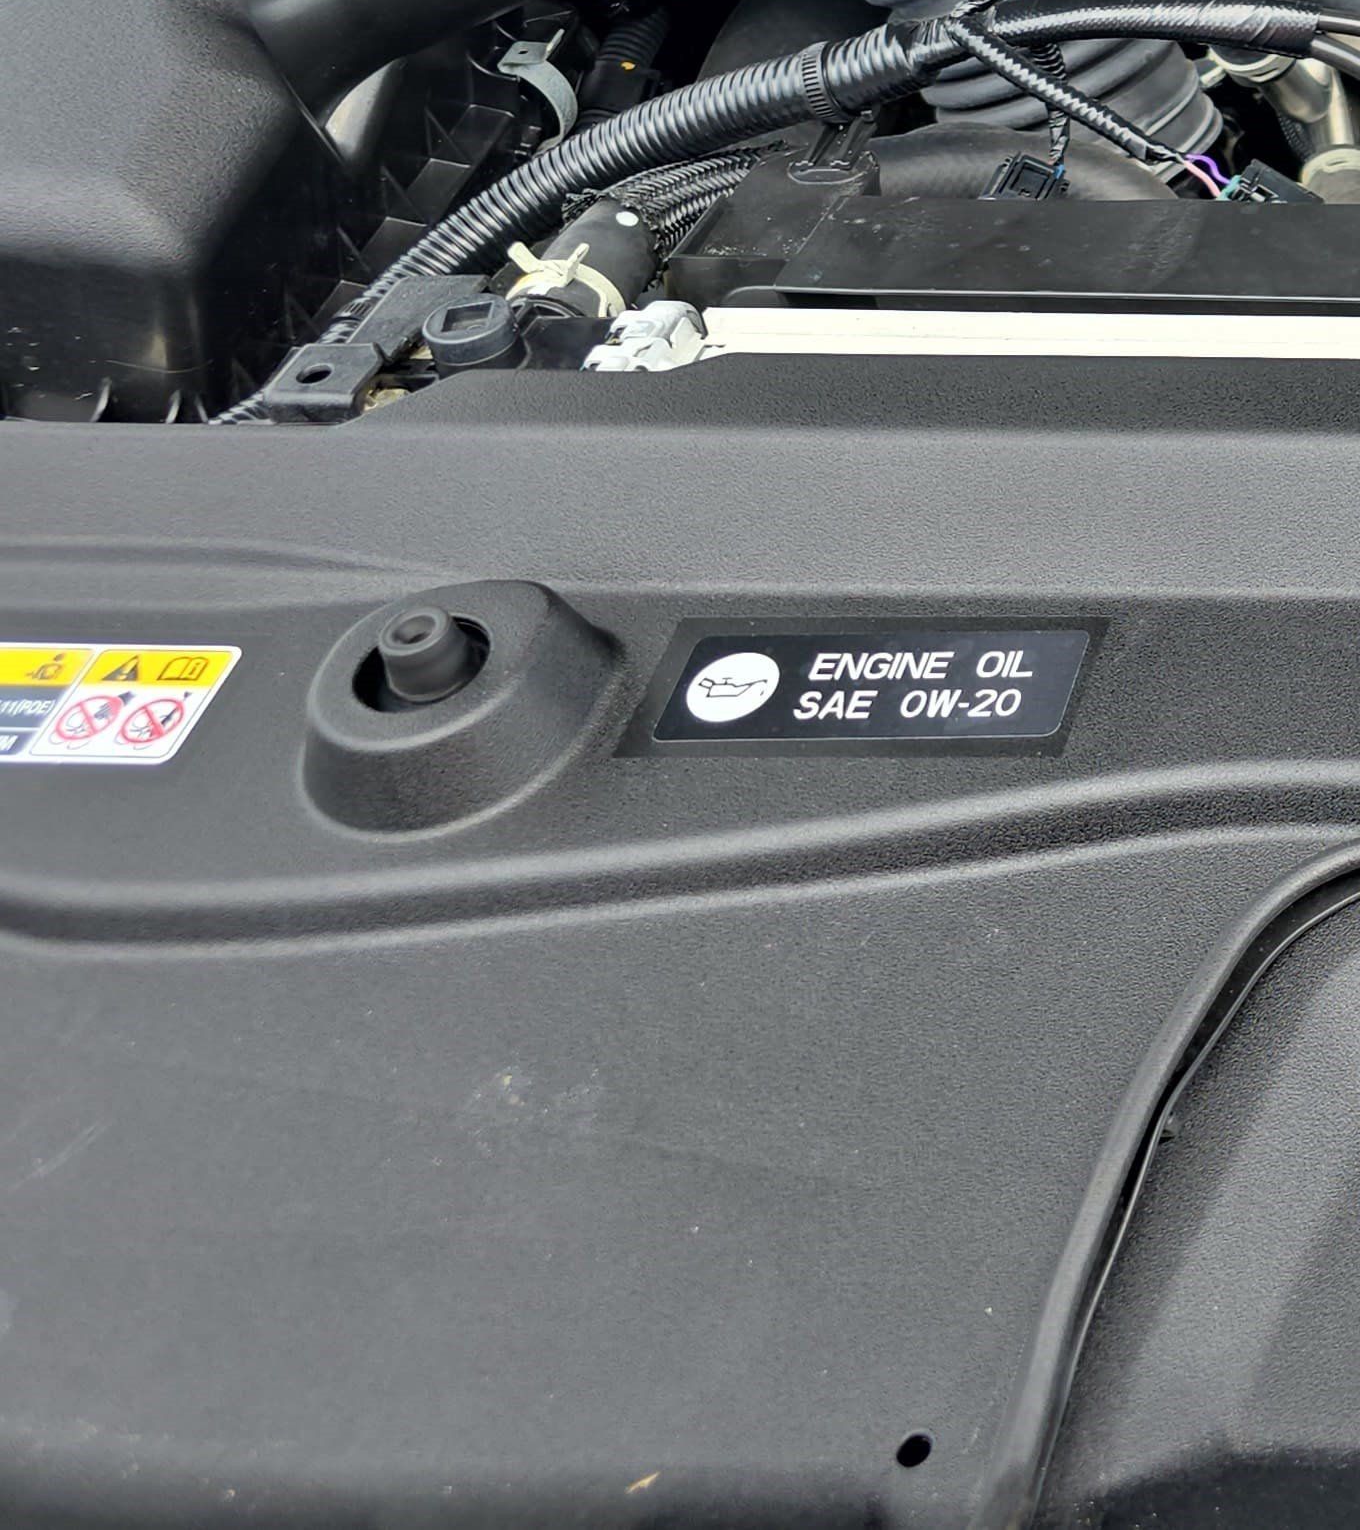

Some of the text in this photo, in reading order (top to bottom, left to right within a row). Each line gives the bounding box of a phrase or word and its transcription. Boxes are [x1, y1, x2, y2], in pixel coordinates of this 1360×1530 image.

[807, 650, 1034, 682] ENGINE OIL
[792, 689, 1023, 721] SAE 0W-20
